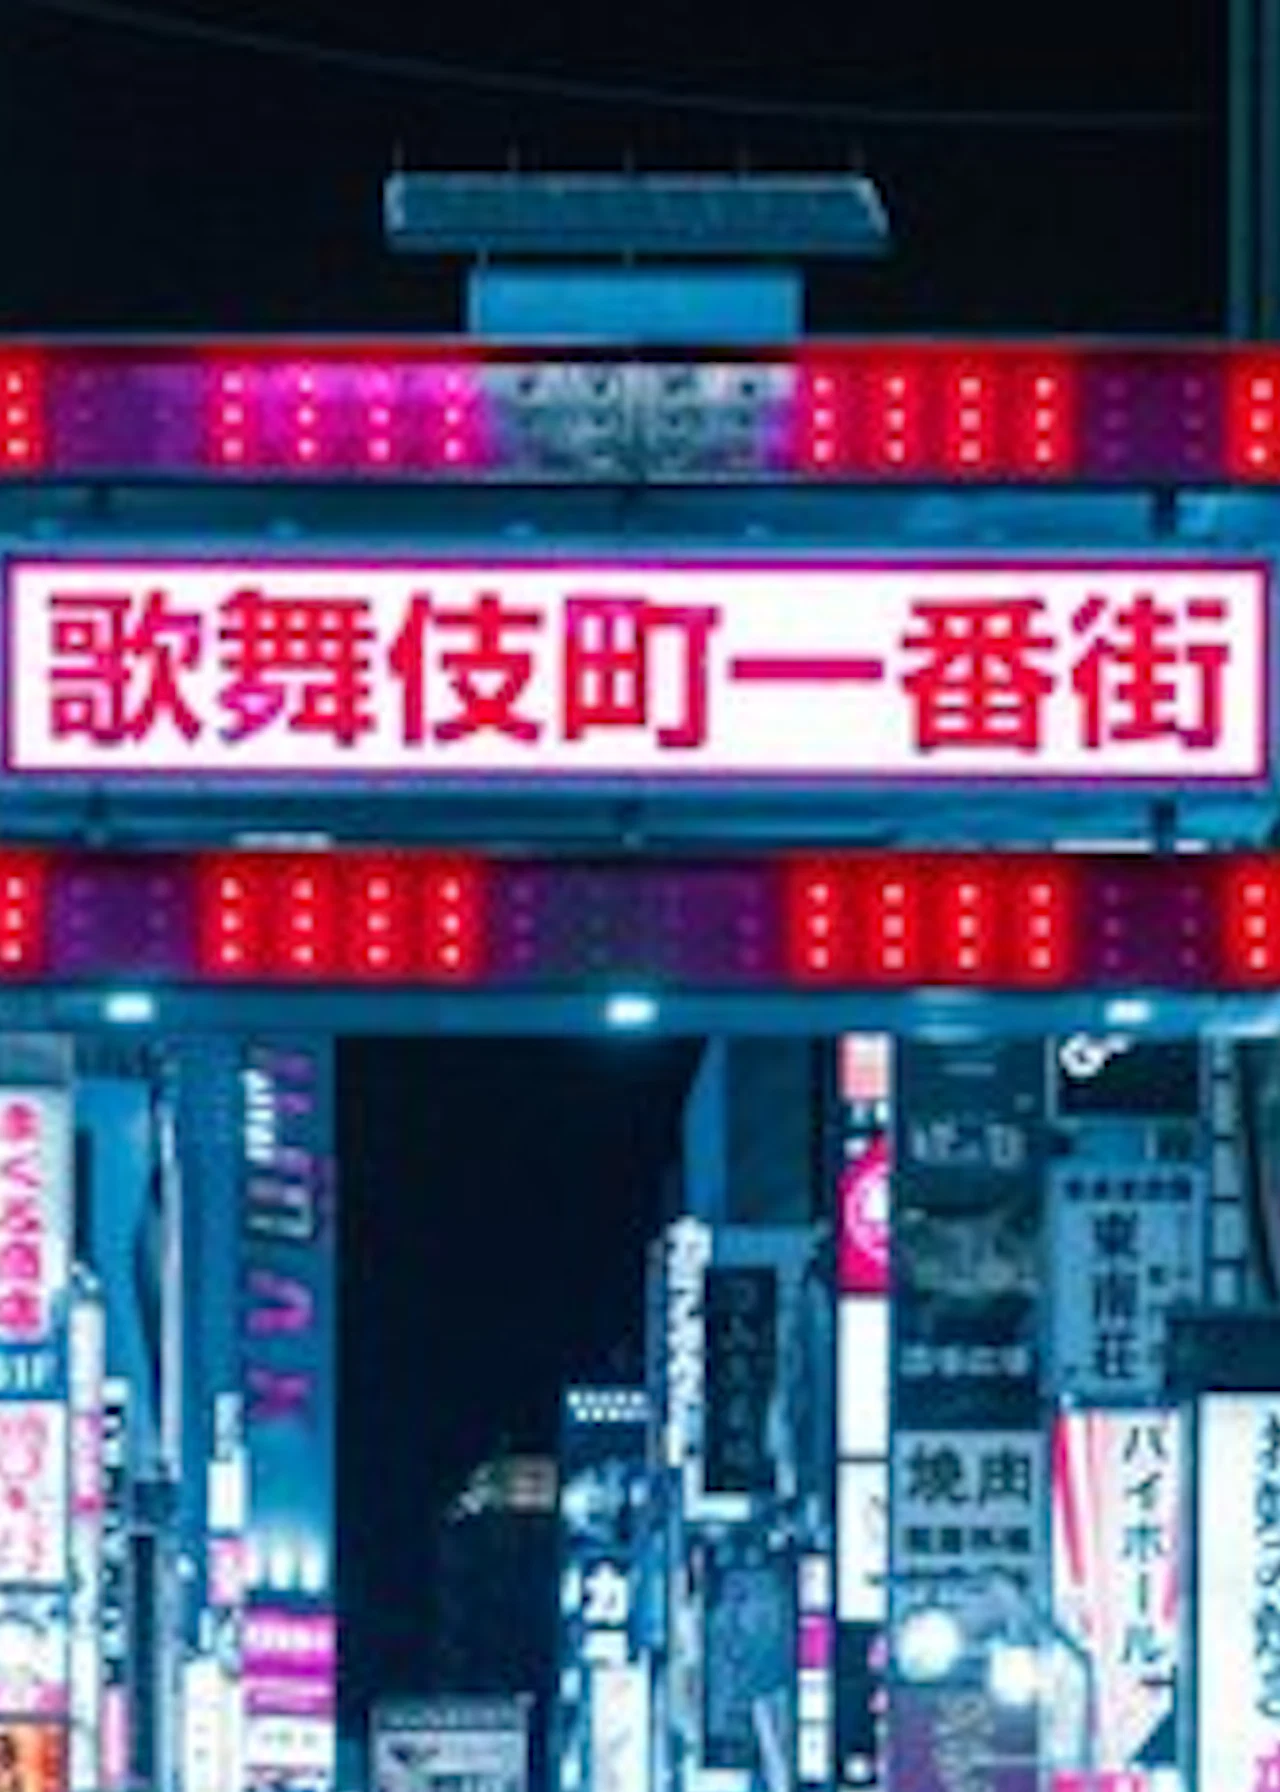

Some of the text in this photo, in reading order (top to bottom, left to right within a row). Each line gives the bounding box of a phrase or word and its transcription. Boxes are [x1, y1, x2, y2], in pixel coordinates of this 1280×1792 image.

[48, 589, 1230, 754] 歌舞伎町一番街
